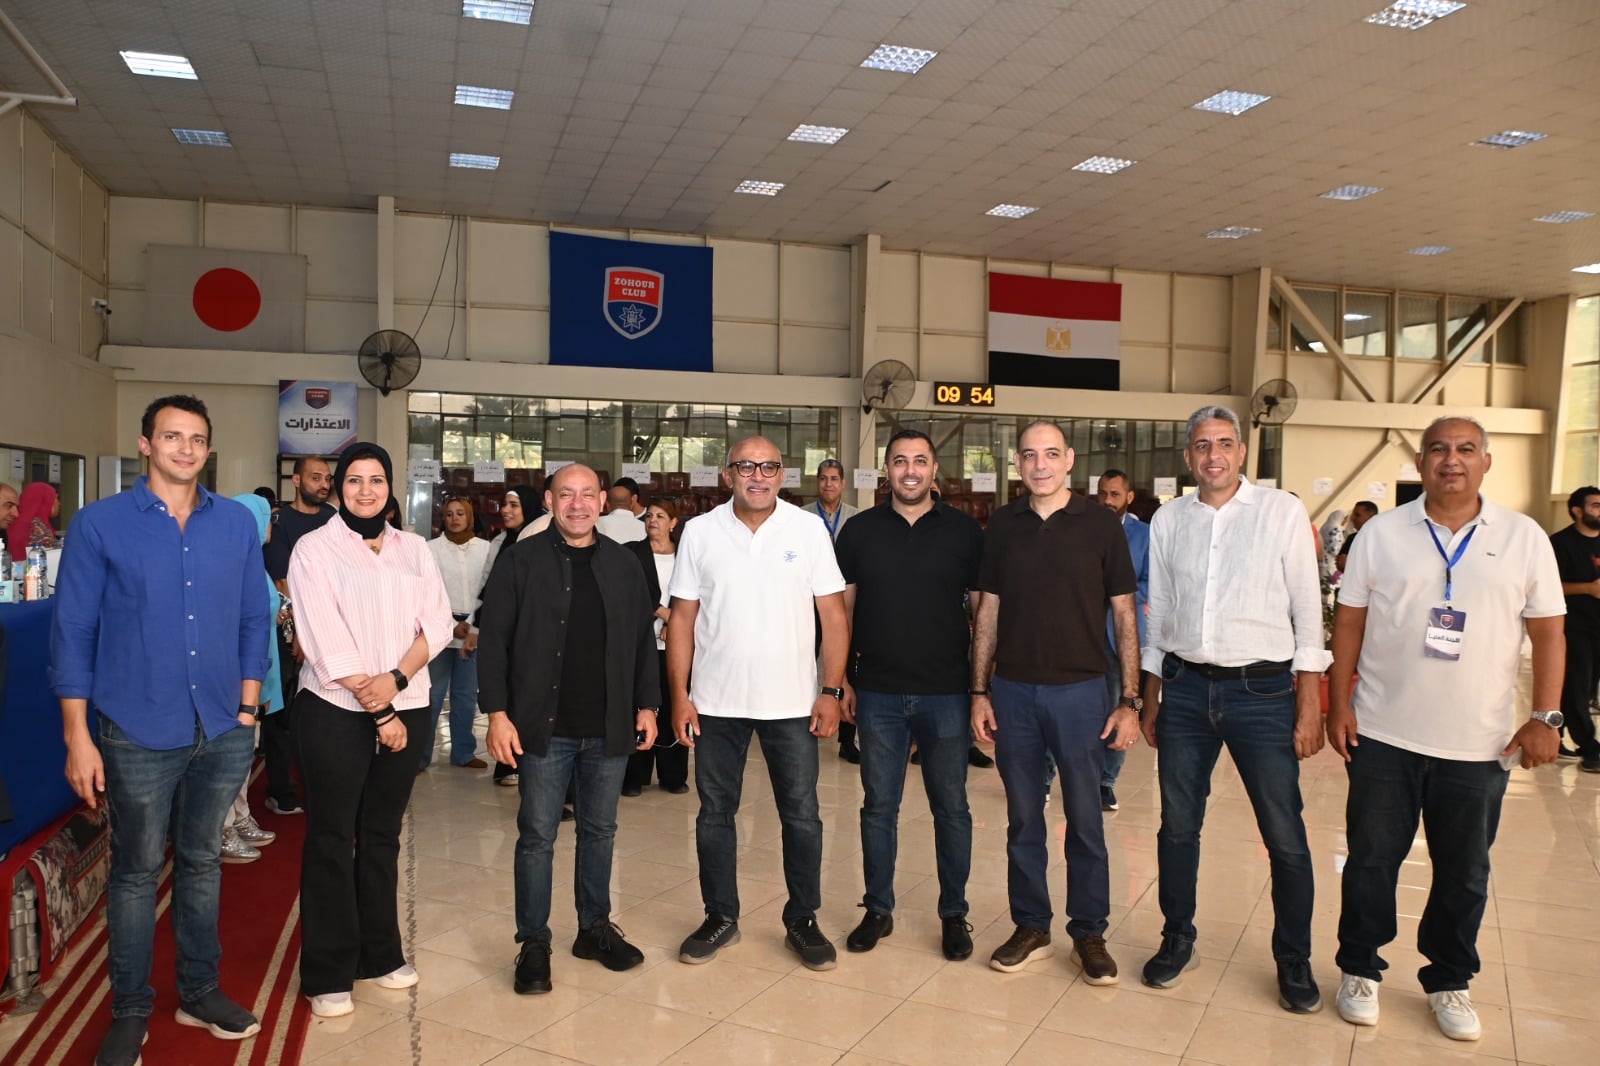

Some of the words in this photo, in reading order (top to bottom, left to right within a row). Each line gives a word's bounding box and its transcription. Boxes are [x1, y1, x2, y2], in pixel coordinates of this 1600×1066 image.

[614, 277, 655, 289] ZOHOUR
[622, 287, 647, 298] CLUB
[937, 385, 961, 403] 09
[970, 387, 994, 405] 54
[285, 417, 351, 431] الاعتذارات
